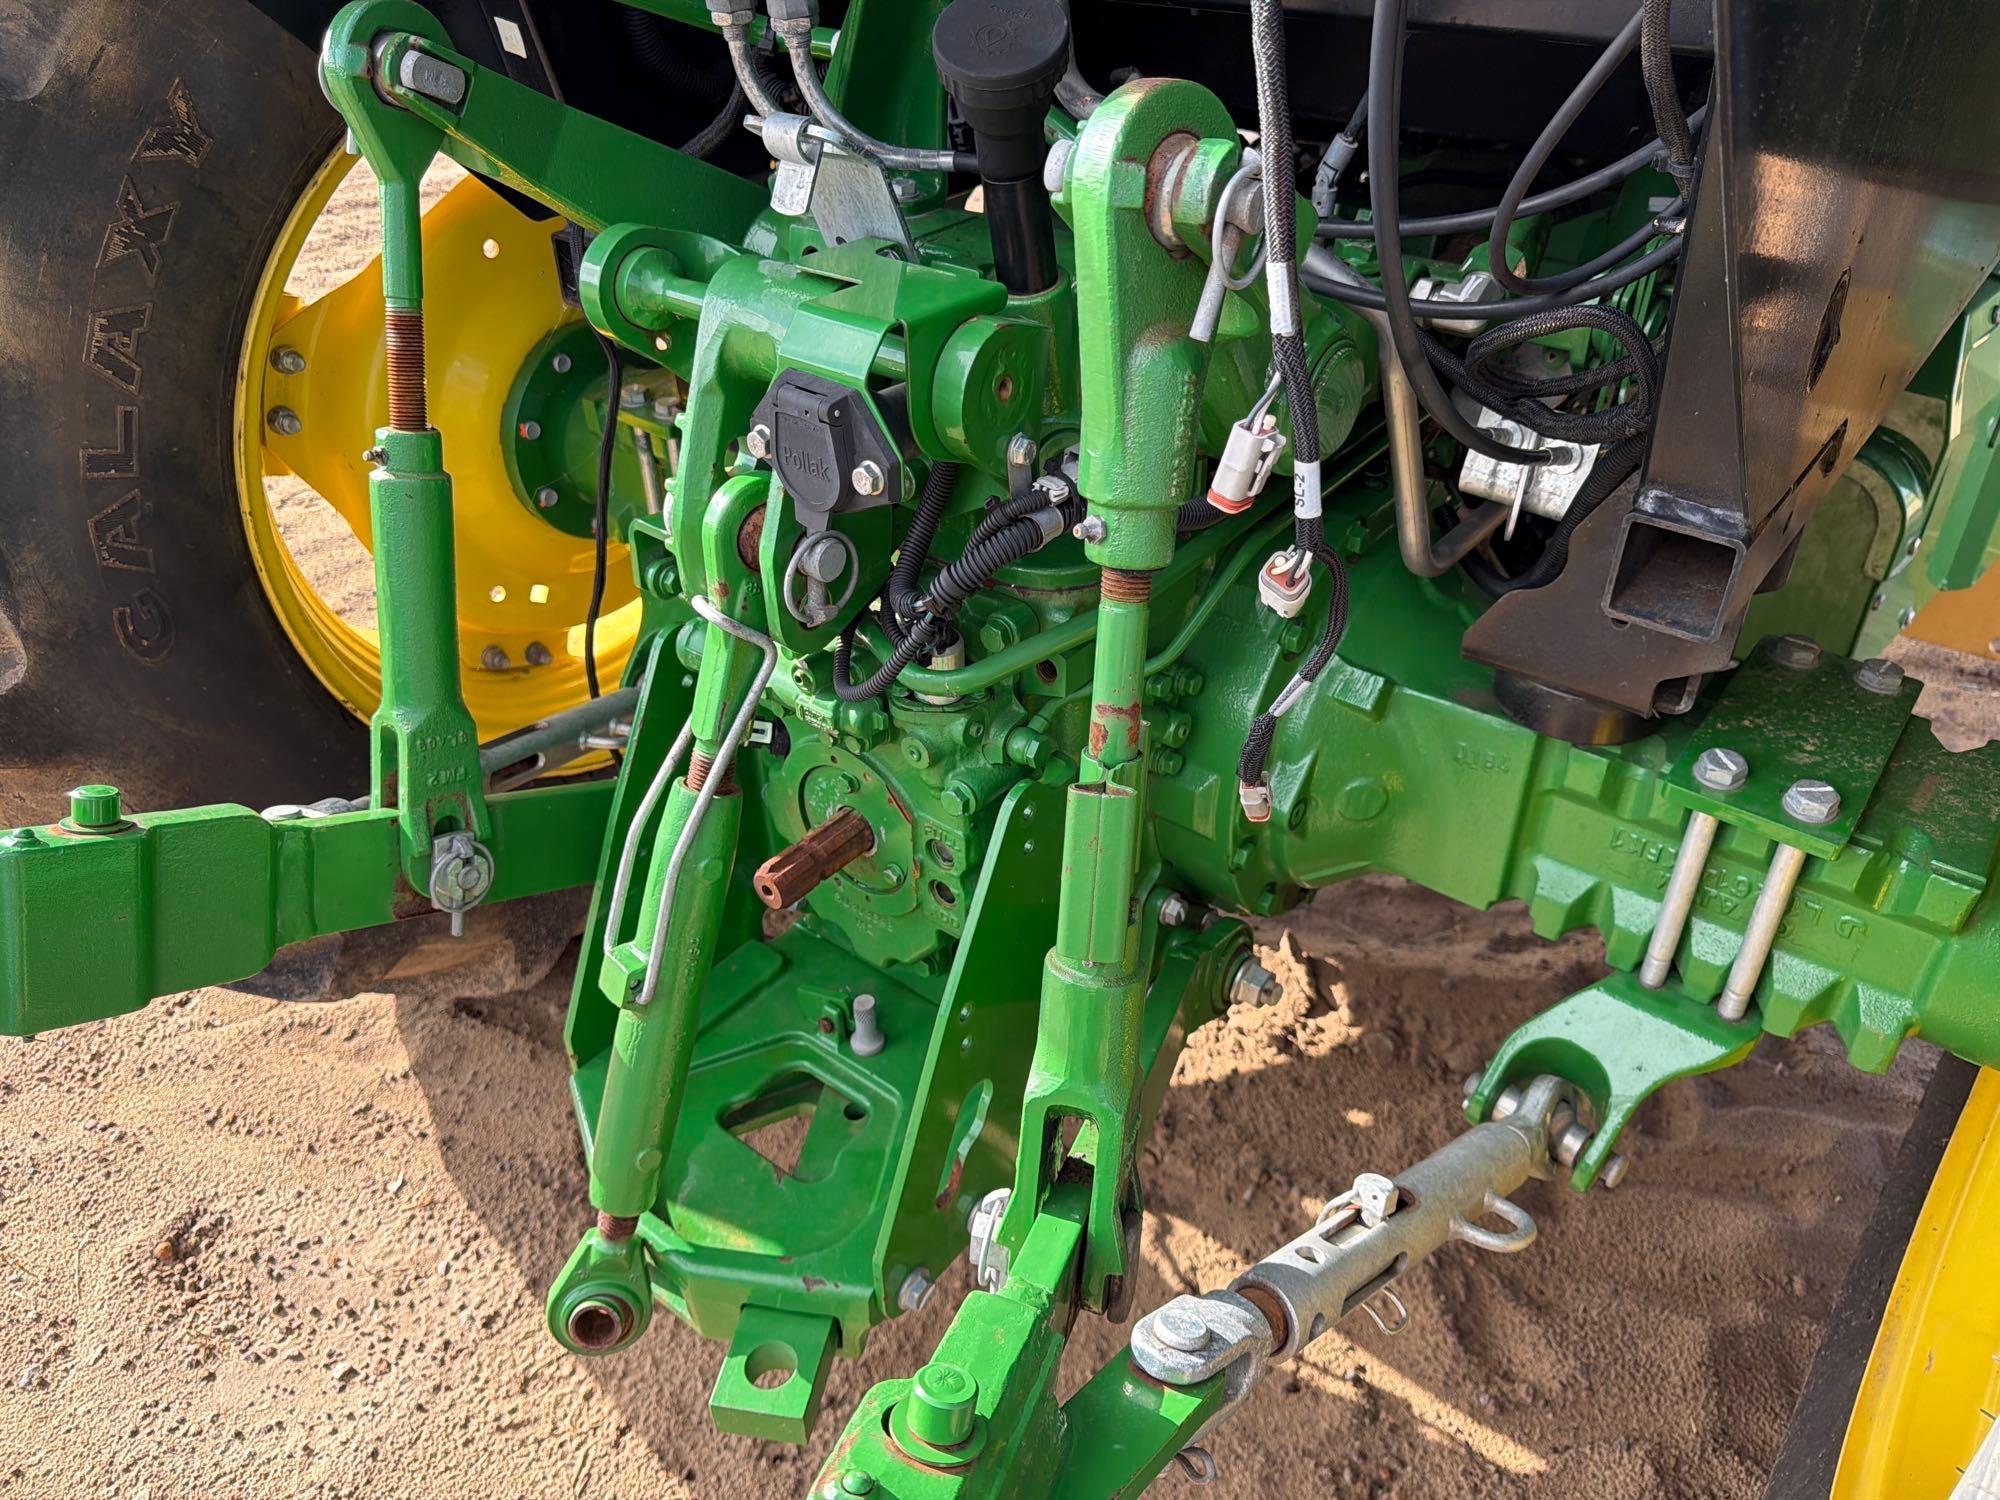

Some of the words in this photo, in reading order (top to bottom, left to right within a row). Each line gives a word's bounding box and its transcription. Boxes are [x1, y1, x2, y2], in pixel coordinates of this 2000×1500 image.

[80, 76, 215, 666] GALAXY
[783, 446, 831, 482] Pollak
[1294, 472, 1306, 508] SL-2
